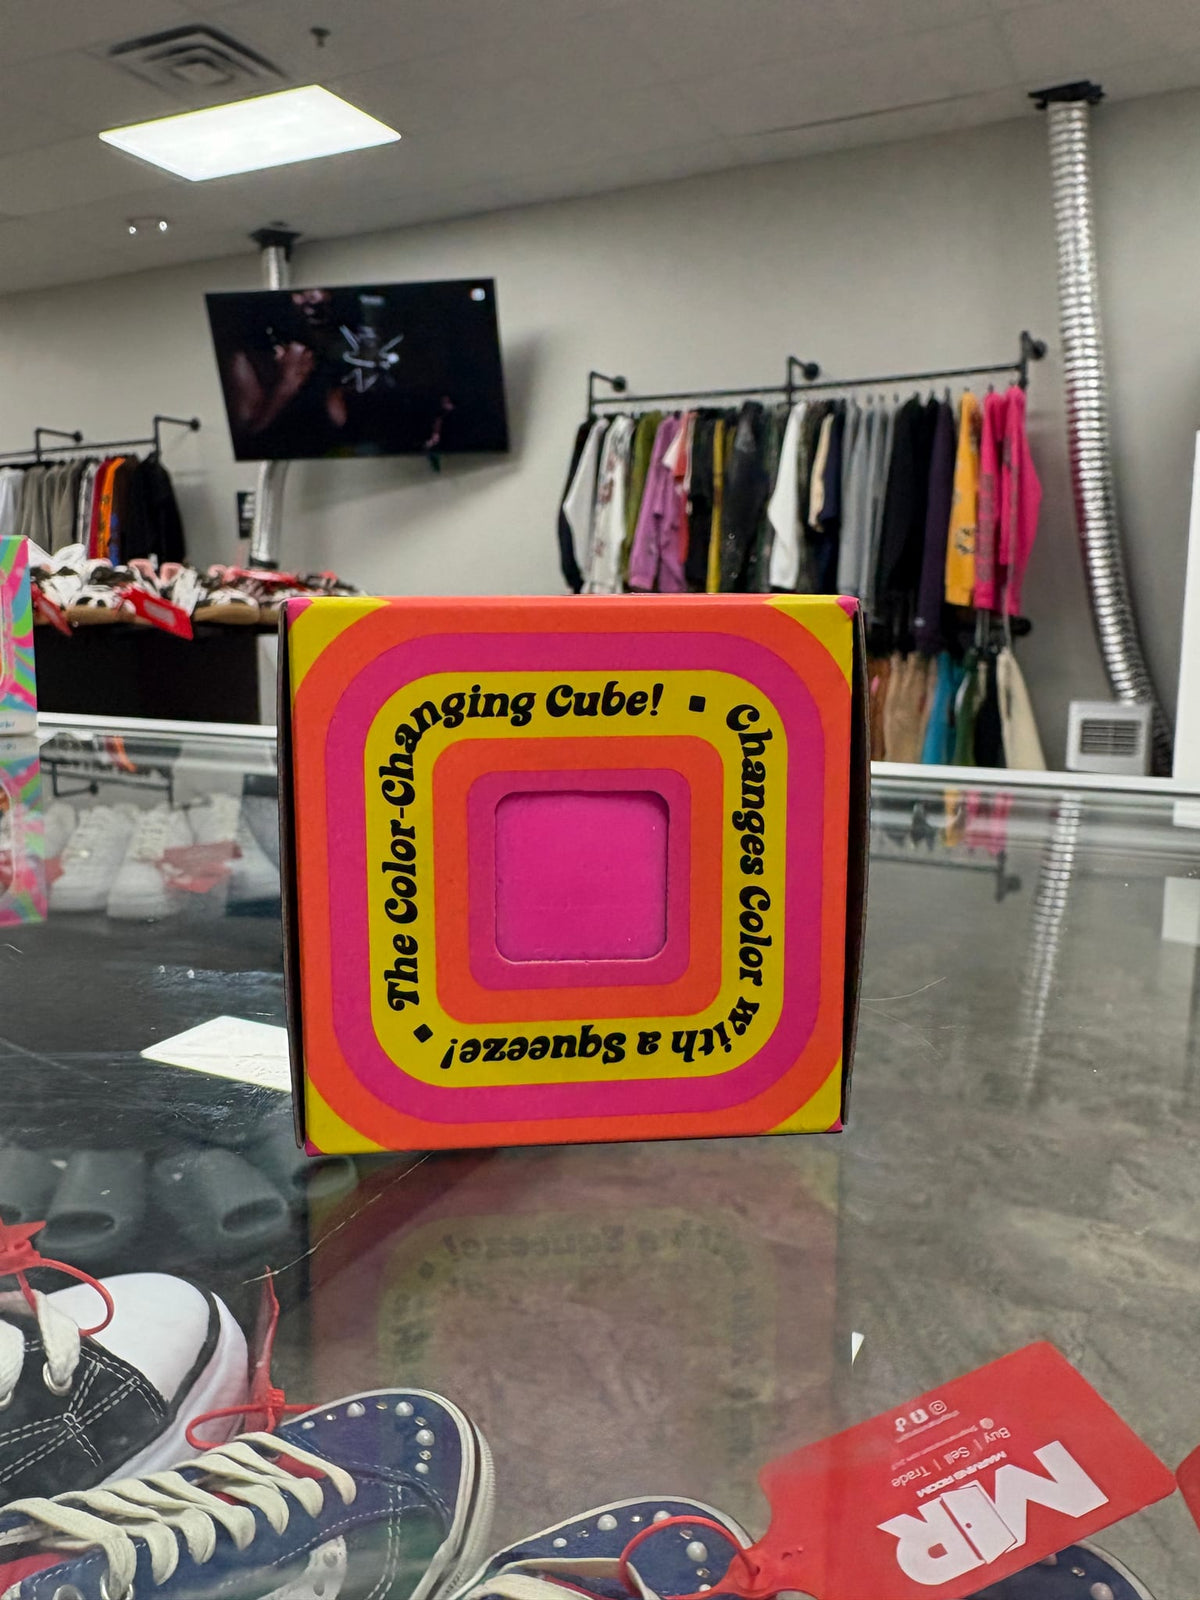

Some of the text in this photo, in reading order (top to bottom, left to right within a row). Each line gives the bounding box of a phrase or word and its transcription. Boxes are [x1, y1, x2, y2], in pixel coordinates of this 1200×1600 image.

[378, 680, 664, 1012] The Color-Changing Cube!
[439, 704, 773, 1070] Changes Color with a Squeeze!
[983, 1427, 1011, 1443] Buy
[944, 1446, 970, 1465] Sell
[891, 1466, 932, 1487] Trade
